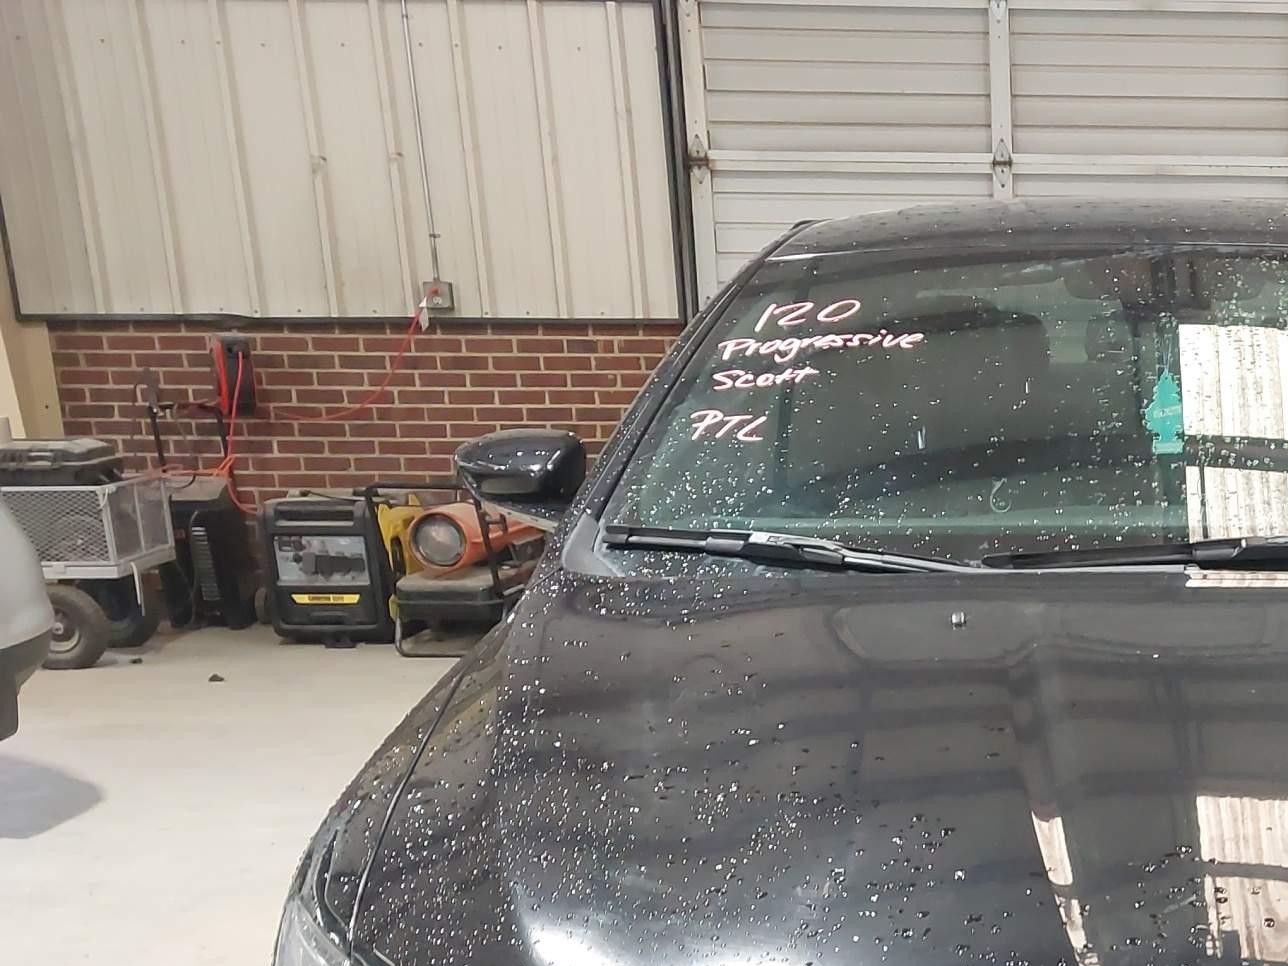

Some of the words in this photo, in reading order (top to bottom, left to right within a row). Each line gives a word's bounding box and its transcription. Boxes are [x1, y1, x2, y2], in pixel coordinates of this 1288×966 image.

[754, 299, 861, 333] 120
[717, 329, 926, 363] Progressive
[712, 367, 820, 391] Scott
